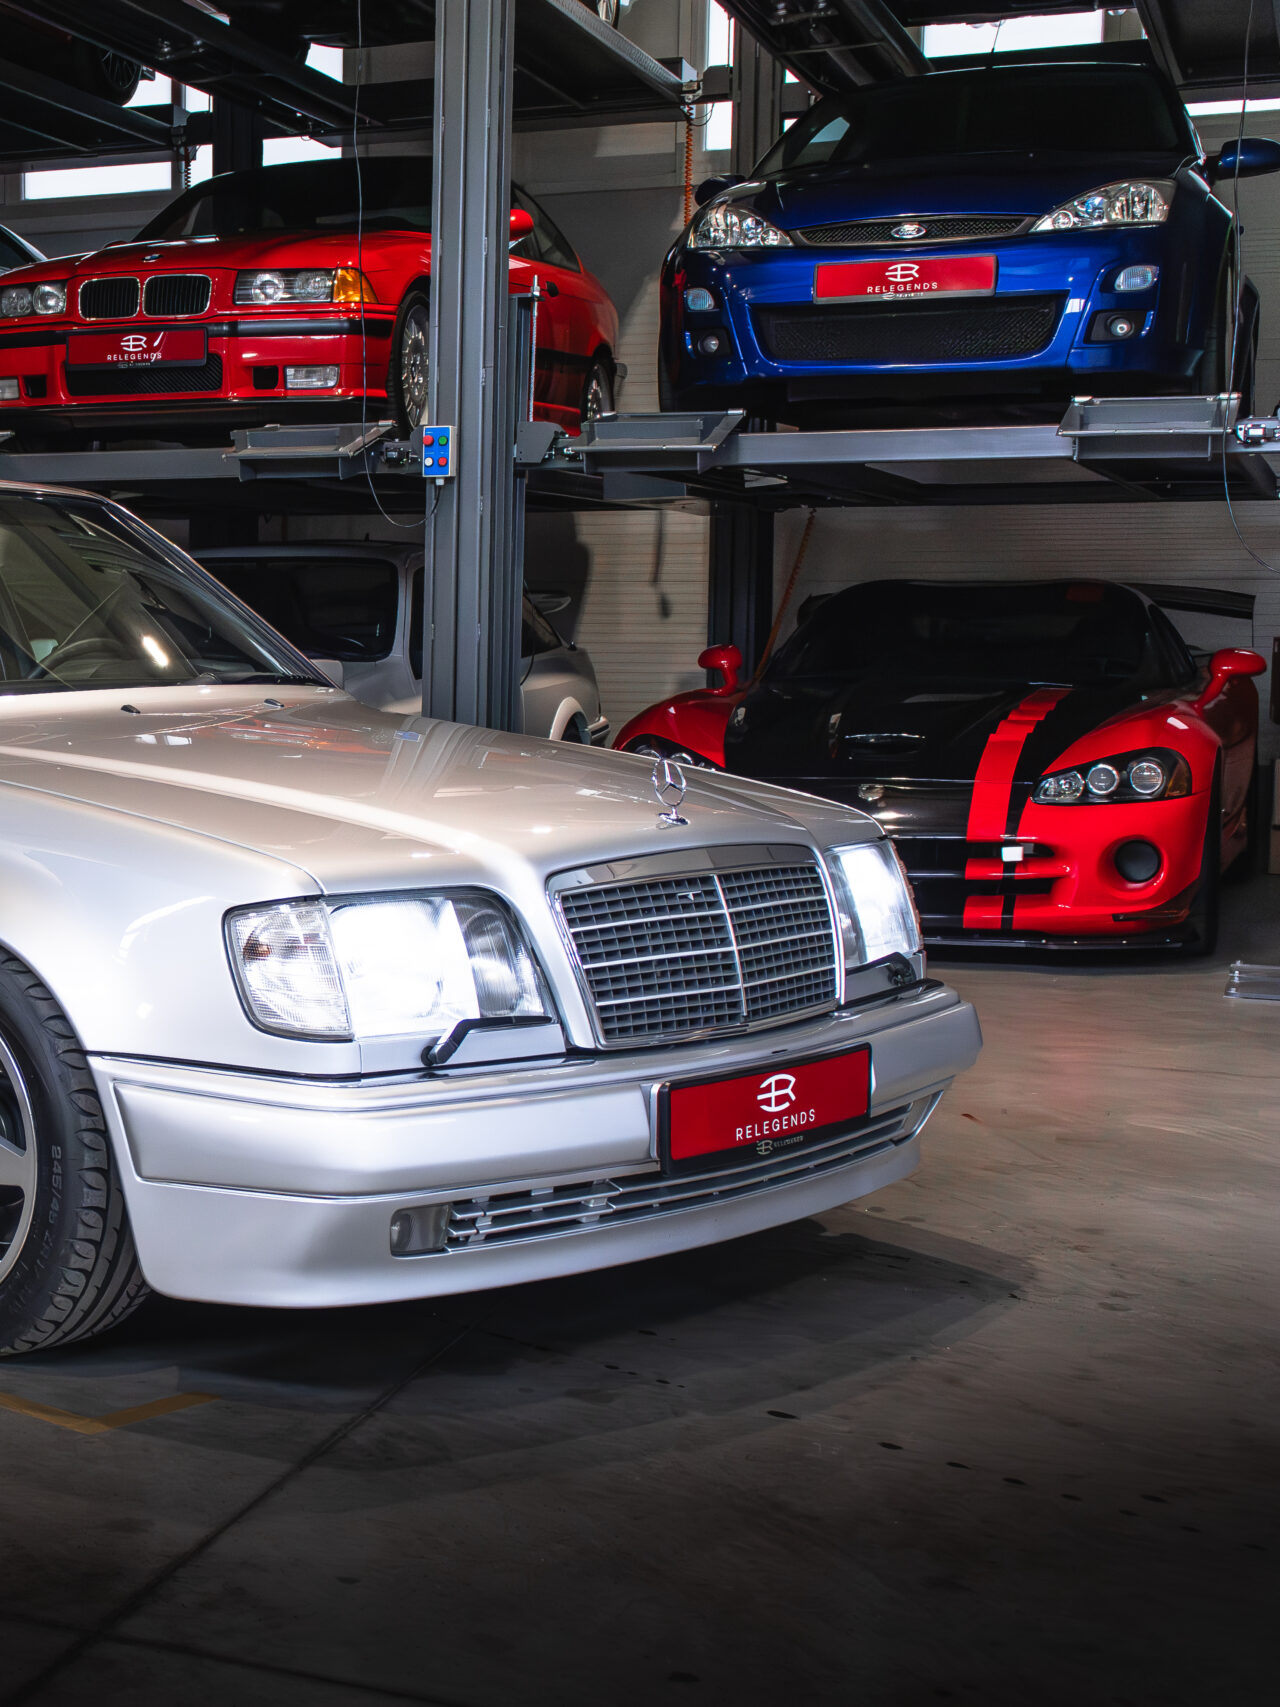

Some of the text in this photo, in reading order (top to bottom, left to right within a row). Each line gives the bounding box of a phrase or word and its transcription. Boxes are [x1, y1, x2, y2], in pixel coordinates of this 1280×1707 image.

[867, 282, 938, 293] RELEGENDS
[107, 353, 162, 361] RELEGENDS
[736, 1109, 816, 1141] RELEGENDS
